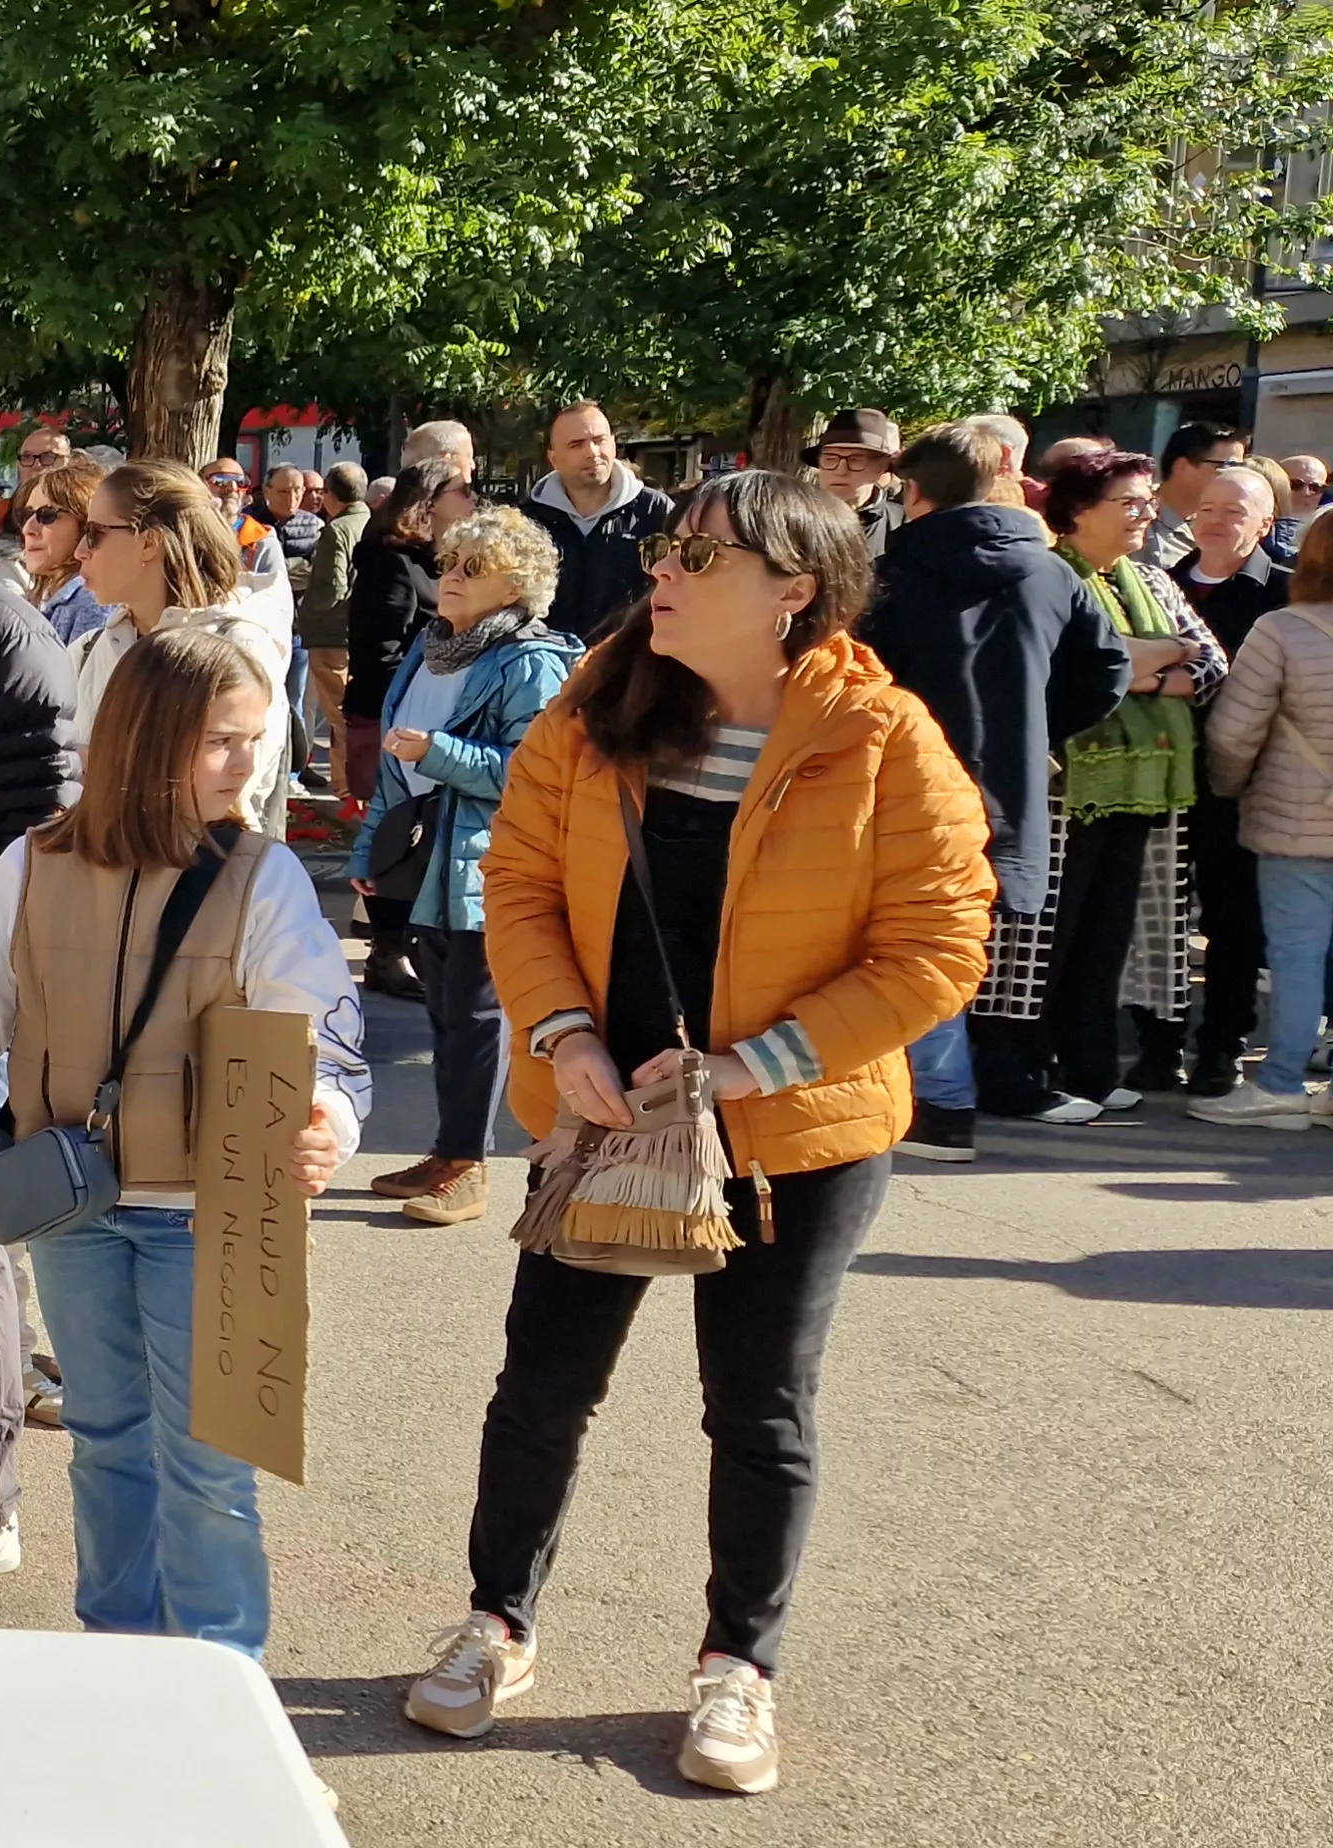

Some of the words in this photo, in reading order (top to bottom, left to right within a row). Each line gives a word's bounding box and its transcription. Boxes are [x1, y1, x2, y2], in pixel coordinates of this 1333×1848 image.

[1167, 363, 1242, 390] MANGO
[226, 1057, 248, 1108] ES
[265, 1070, 298, 1129] LA
[222, 1133, 245, 1182] UN
[259, 1151, 285, 1298] SALUD
[218, 1210, 243, 1376] NEGOCIO
[257, 1338, 292, 1417] NO
